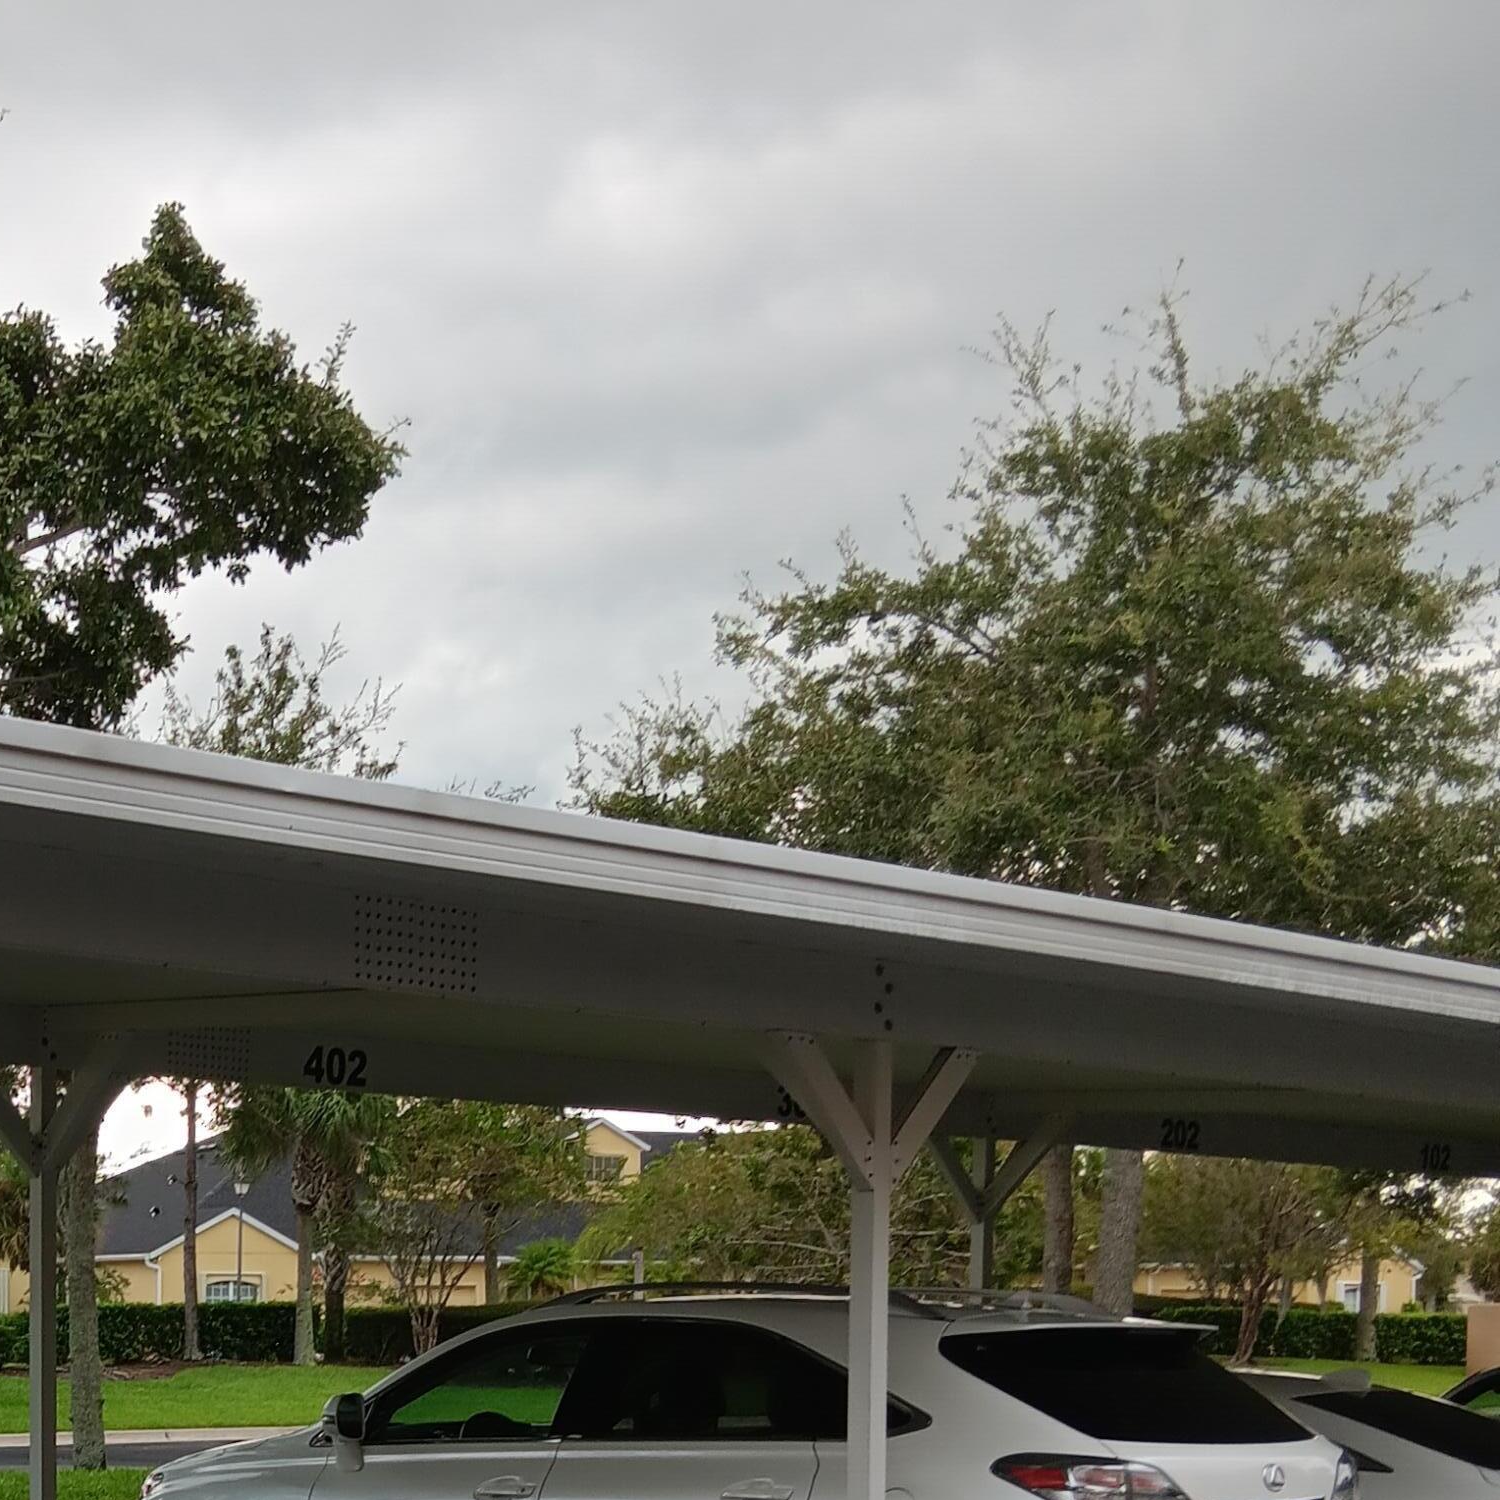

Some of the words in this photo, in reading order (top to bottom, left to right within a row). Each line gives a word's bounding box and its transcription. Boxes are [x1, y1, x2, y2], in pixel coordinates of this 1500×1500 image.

[303, 1045, 367, 1087] 402
[1160, 1118, 1200, 1150] 202
[1420, 1144, 1451, 1171] 102
